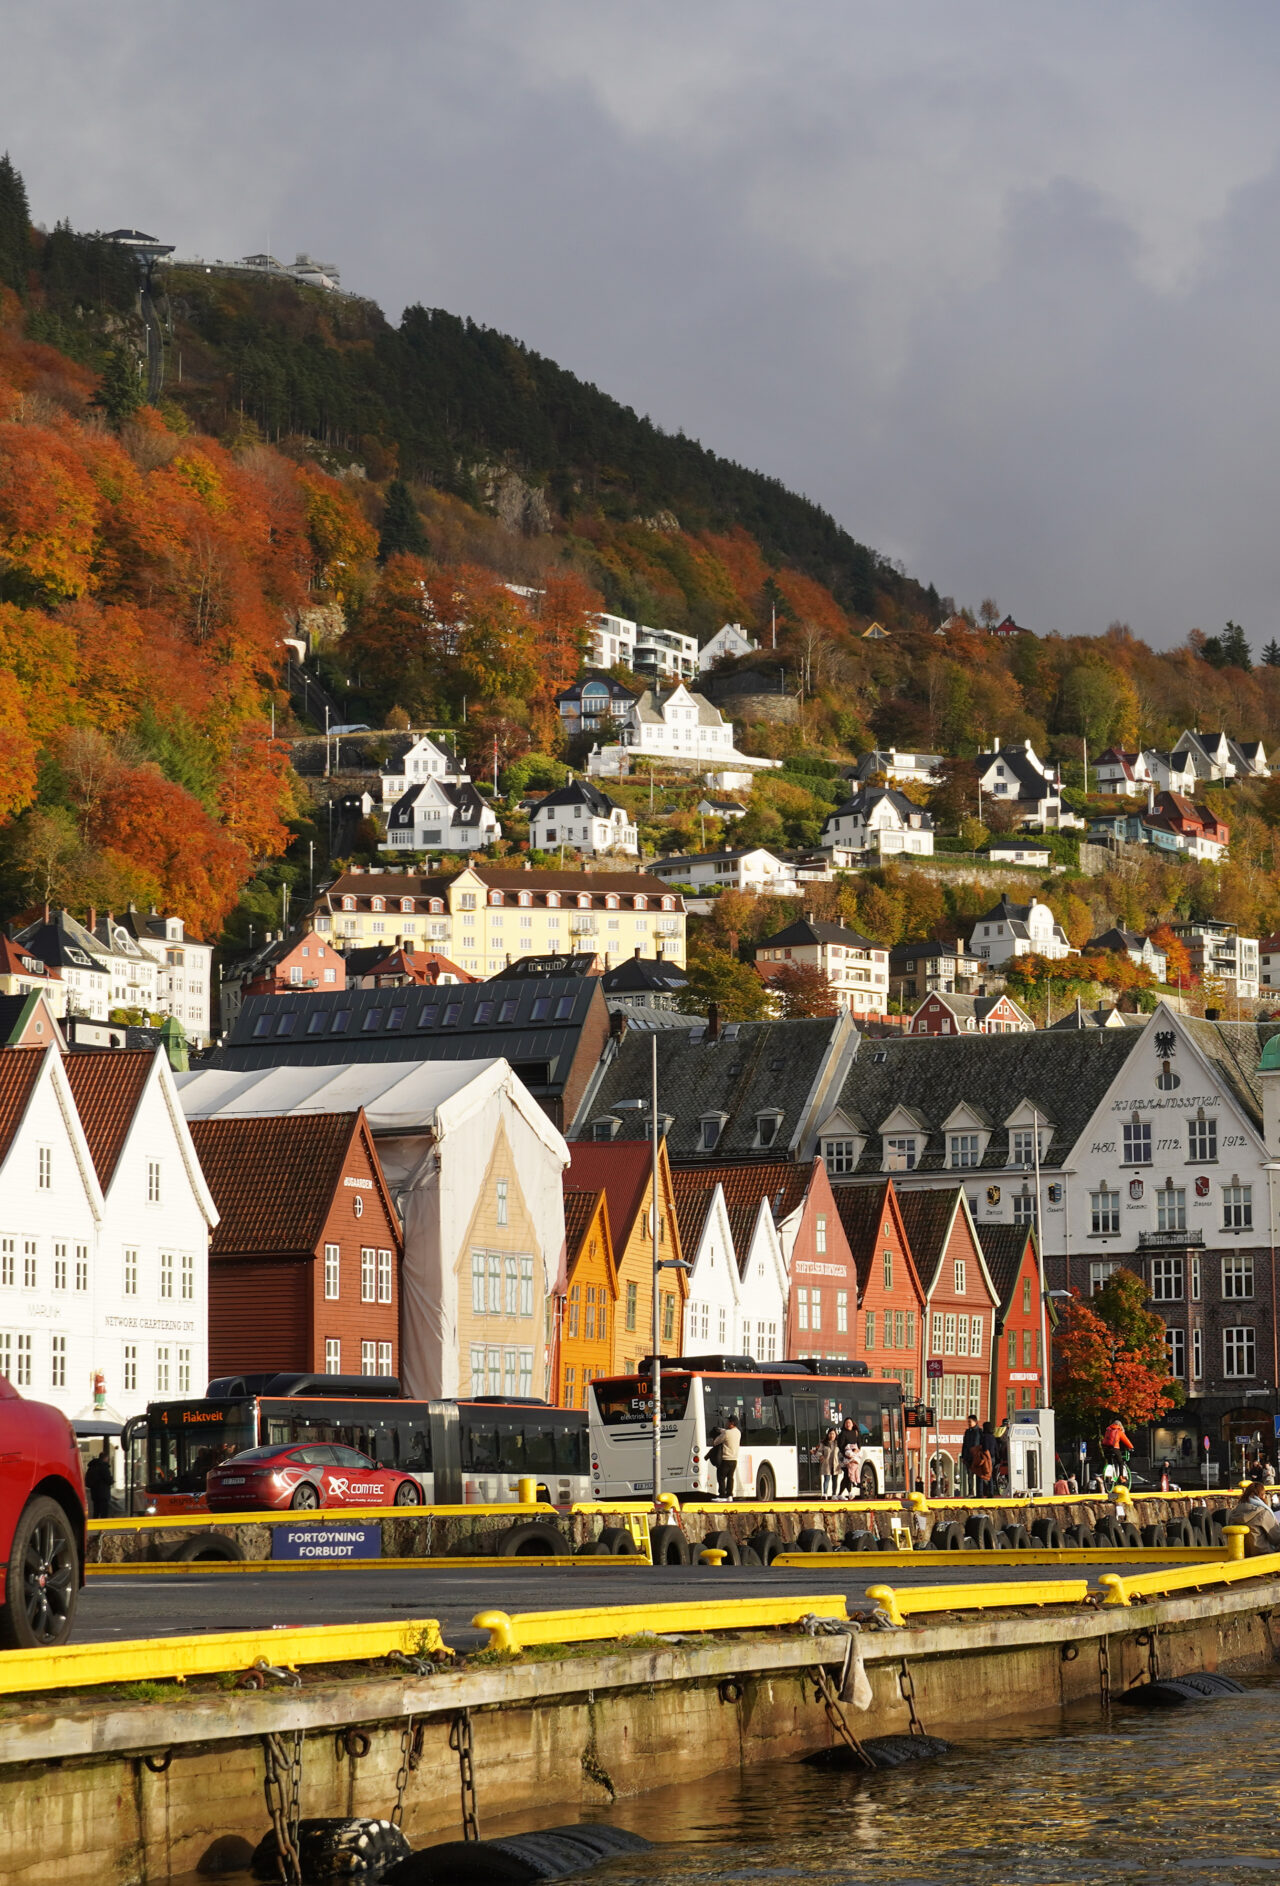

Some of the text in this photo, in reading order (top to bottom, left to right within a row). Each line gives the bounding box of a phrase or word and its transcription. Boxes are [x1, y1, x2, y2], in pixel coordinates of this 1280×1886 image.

[1157, 1139, 1182, 1150] 1712.
[1222, 1136, 1248, 1147] 1912.
[105, 1316, 138, 1328] NETWORK
[139, 1318, 182, 1331] CHARTERING
[637, 1382, 647, 1394] 10
[632, 1399, 646, 1410] Eg
[161, 1411, 224, 1424] 4 Flaktveit
[350, 1483, 385, 1495] COMTEC
[288, 1532, 365, 1543] FORTØYNING
[299, 1546, 354, 1556] FORBUDT
